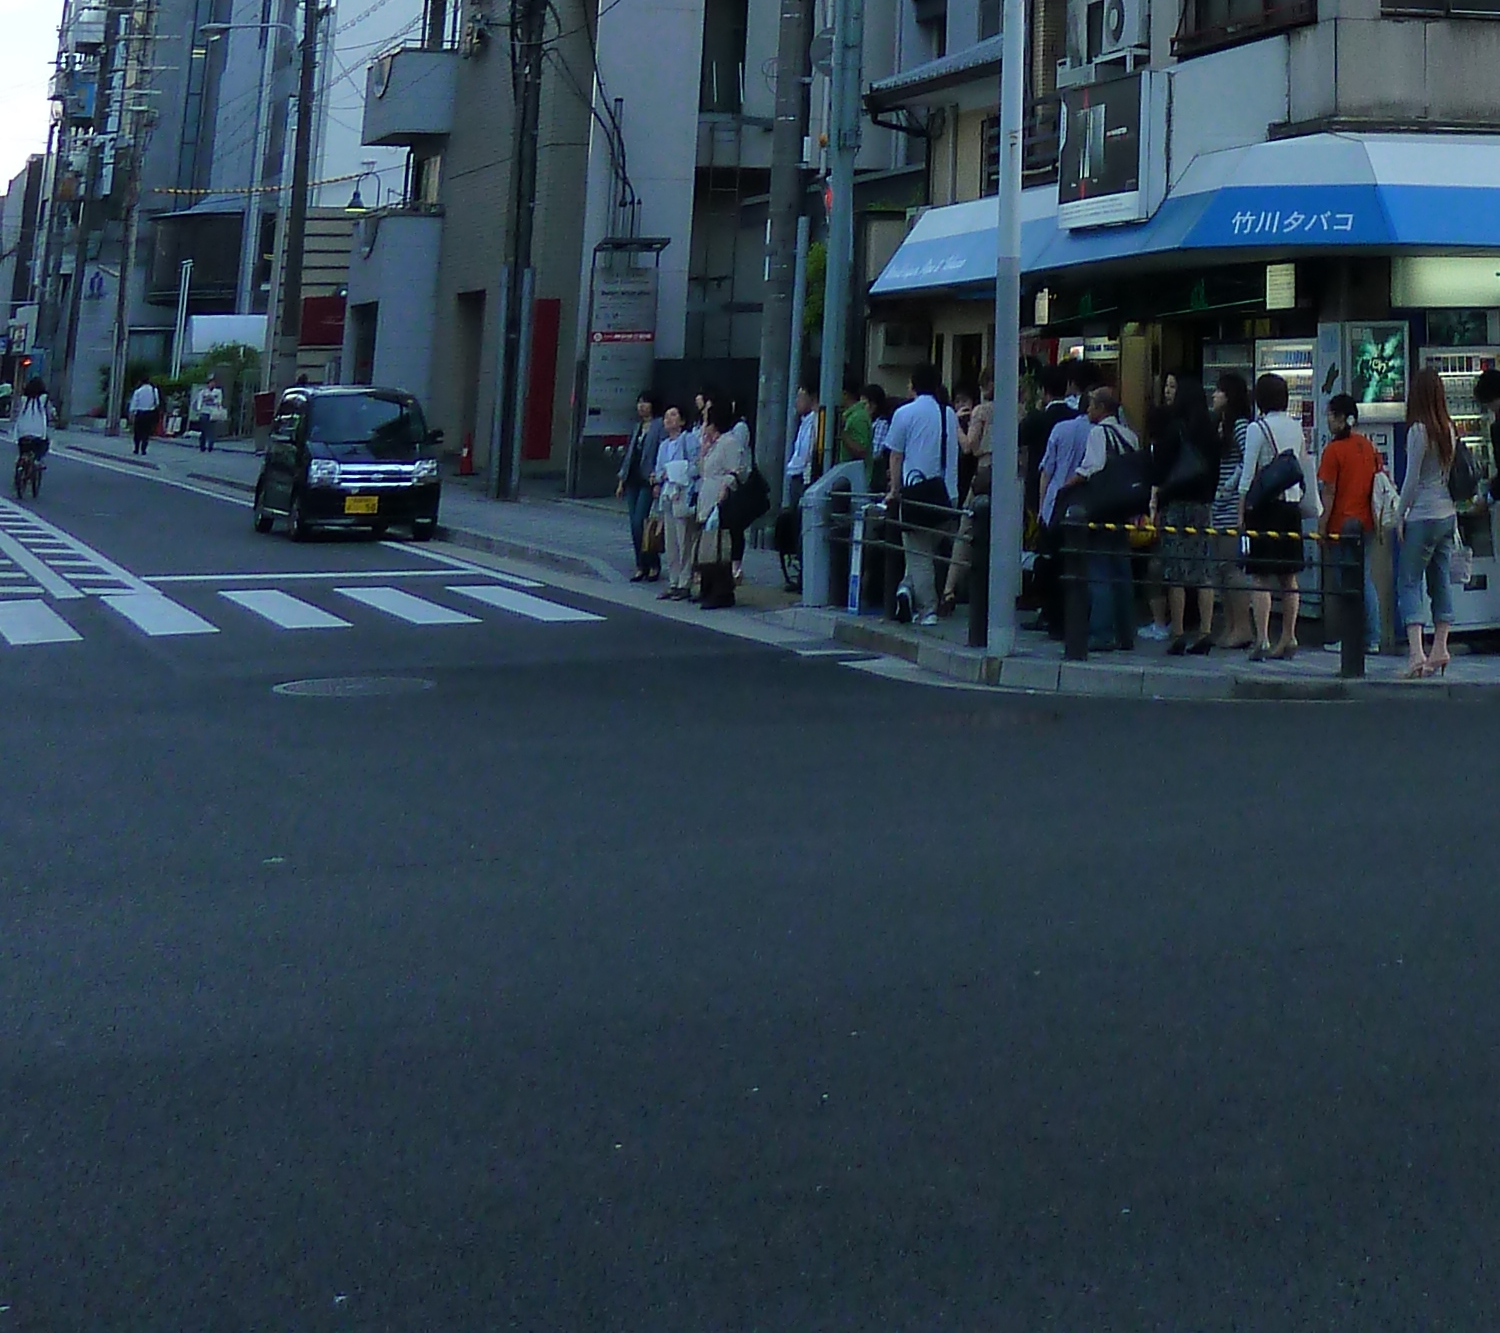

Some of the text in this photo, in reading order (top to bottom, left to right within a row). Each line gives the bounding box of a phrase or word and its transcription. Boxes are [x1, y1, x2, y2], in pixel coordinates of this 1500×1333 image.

[1232, 211, 1355, 235] 竹川タバコ
